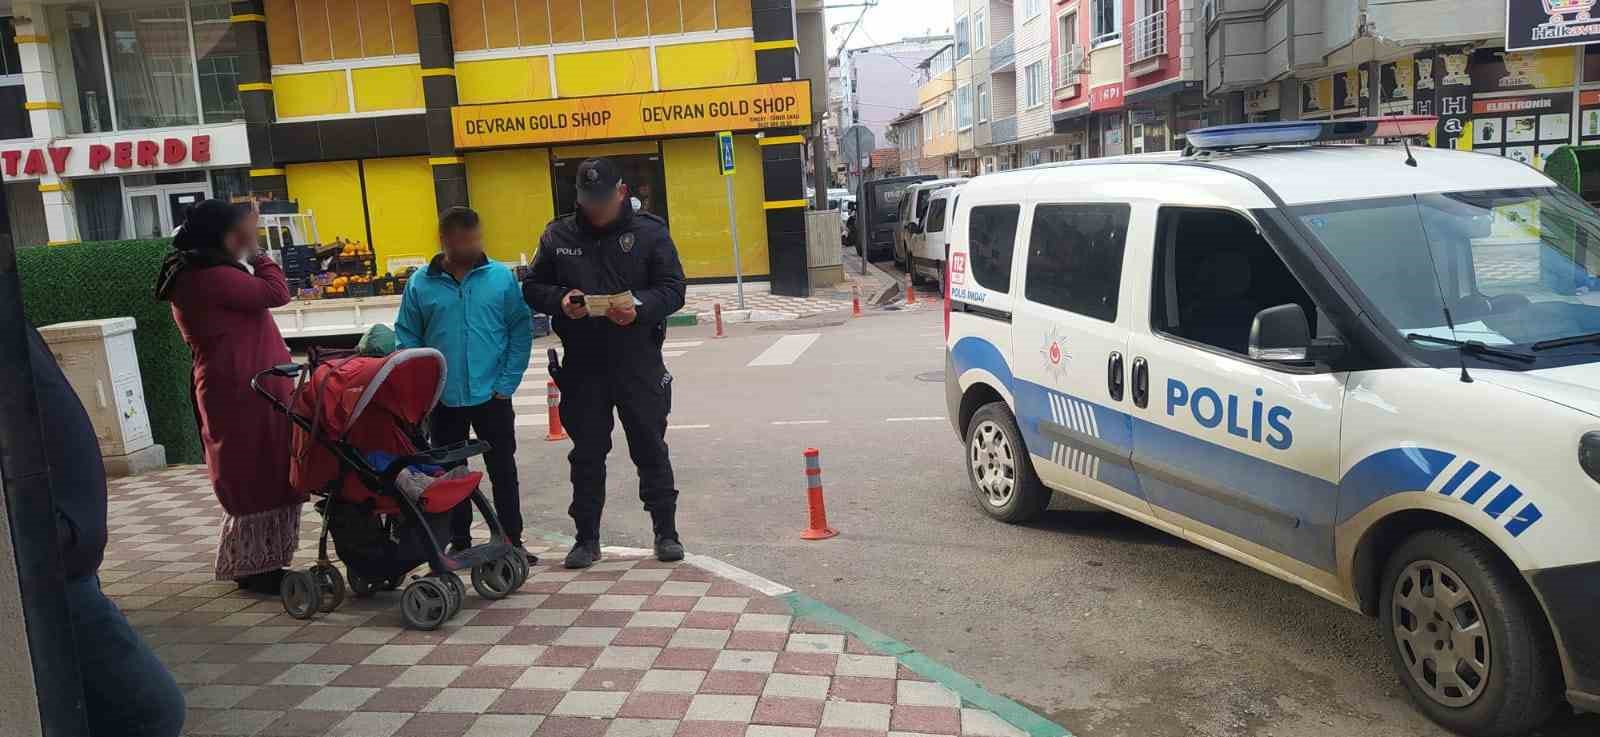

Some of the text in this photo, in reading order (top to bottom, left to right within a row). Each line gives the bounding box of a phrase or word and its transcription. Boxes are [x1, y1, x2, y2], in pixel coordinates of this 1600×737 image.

[465, 110, 612, 136] DEVRAN GOLD SHOP
[642, 103, 705, 123] DEVRAN
[708, 99, 750, 118] GOLD
[753, 96, 796, 115] SHOP
[1, 134, 211, 177] TAY PERDE
[1166, 377, 1294, 450] POLİS
